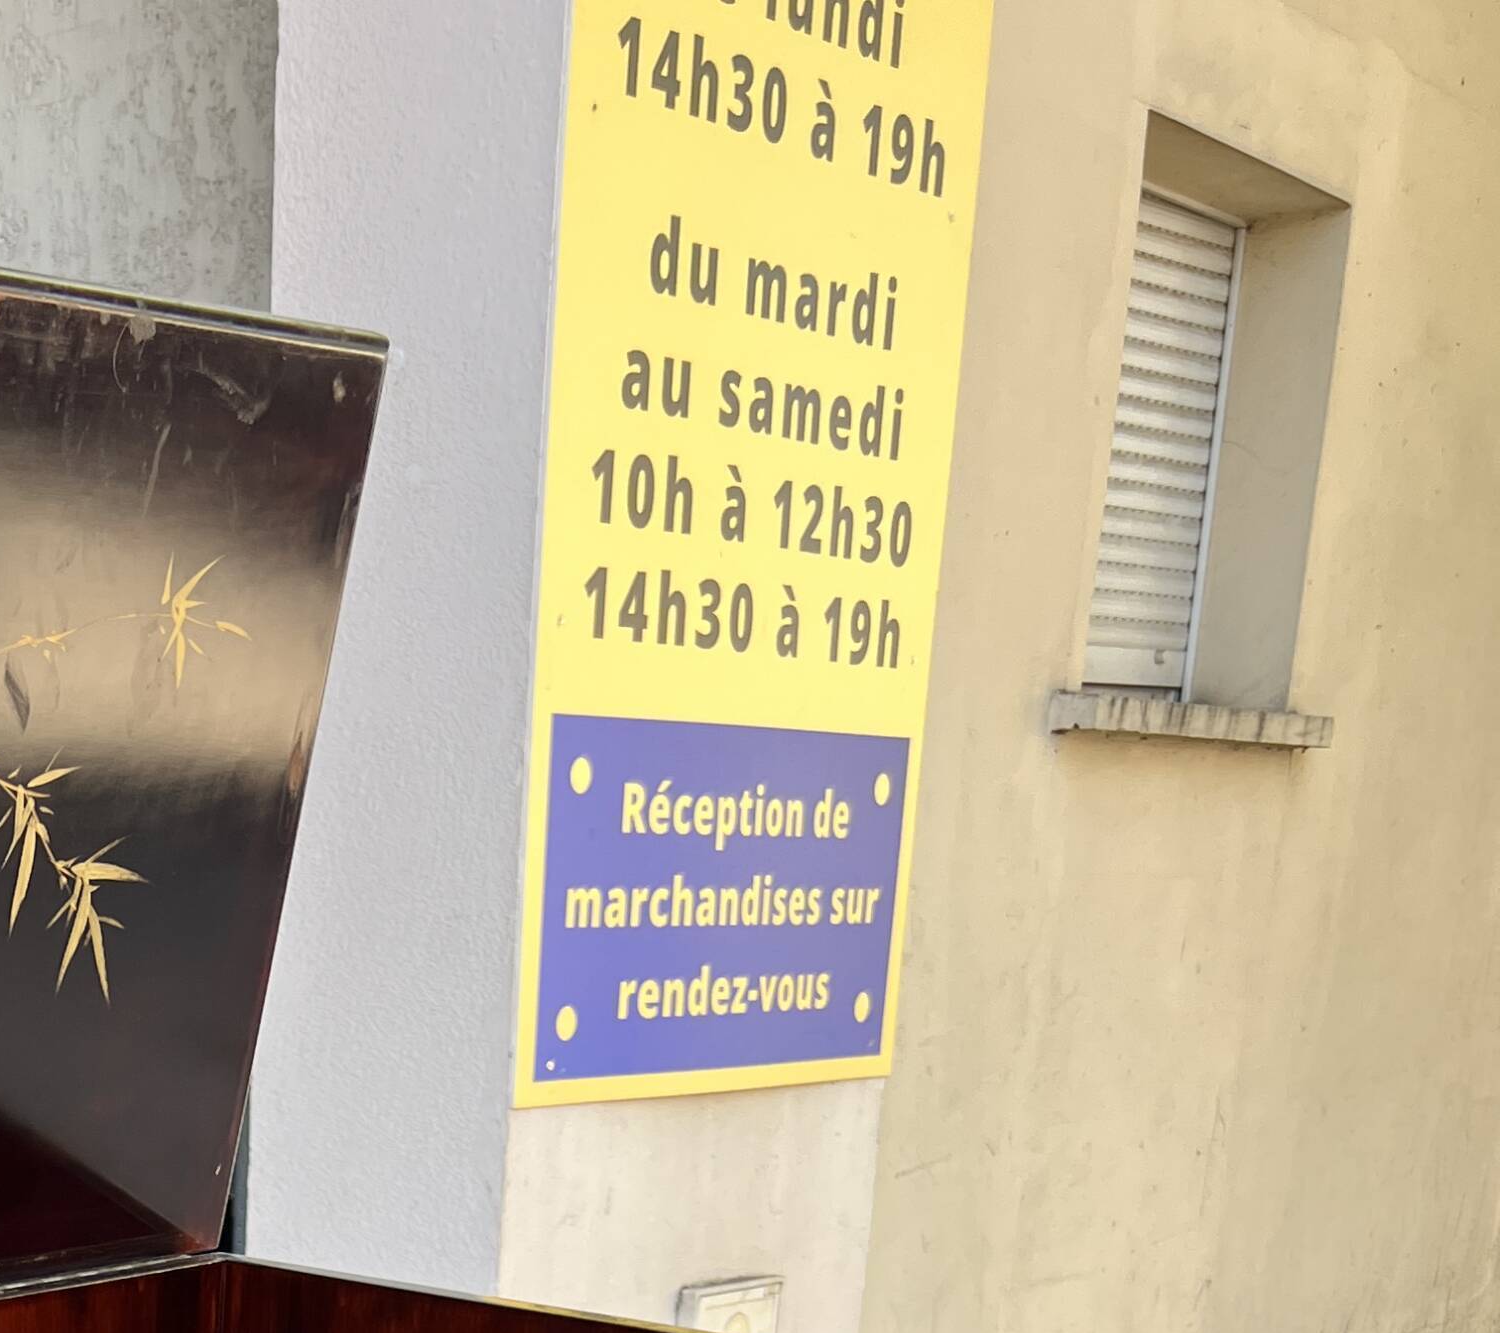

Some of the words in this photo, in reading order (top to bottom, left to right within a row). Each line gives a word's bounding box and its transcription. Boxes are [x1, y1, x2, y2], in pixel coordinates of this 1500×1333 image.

[766, 0, 905, 69] undi
[617, 16, 787, 144] 14h30
[810, 78, 836, 163] à
[863, 104, 945, 198] 19h
[650, 214, 719, 306] du
[745, 257, 898, 351] mardi
[621, 349, 692, 419] au
[718, 369, 904, 461] samedi
[592, 449, 693, 535] 10h
[720, 464, 747, 543] à
[774, 480, 912, 568] 12h30
[584, 566, 754, 653] 14h30
[776, 584, 799, 658] à
[824, 597, 900, 669] 19h
[621, 779, 804, 851] Réception
[813, 788, 850, 839] de
[565, 874, 823, 929] marchandises
[829, 887, 880, 925] sur
[617, 964, 830, 1020] rendez-vous
